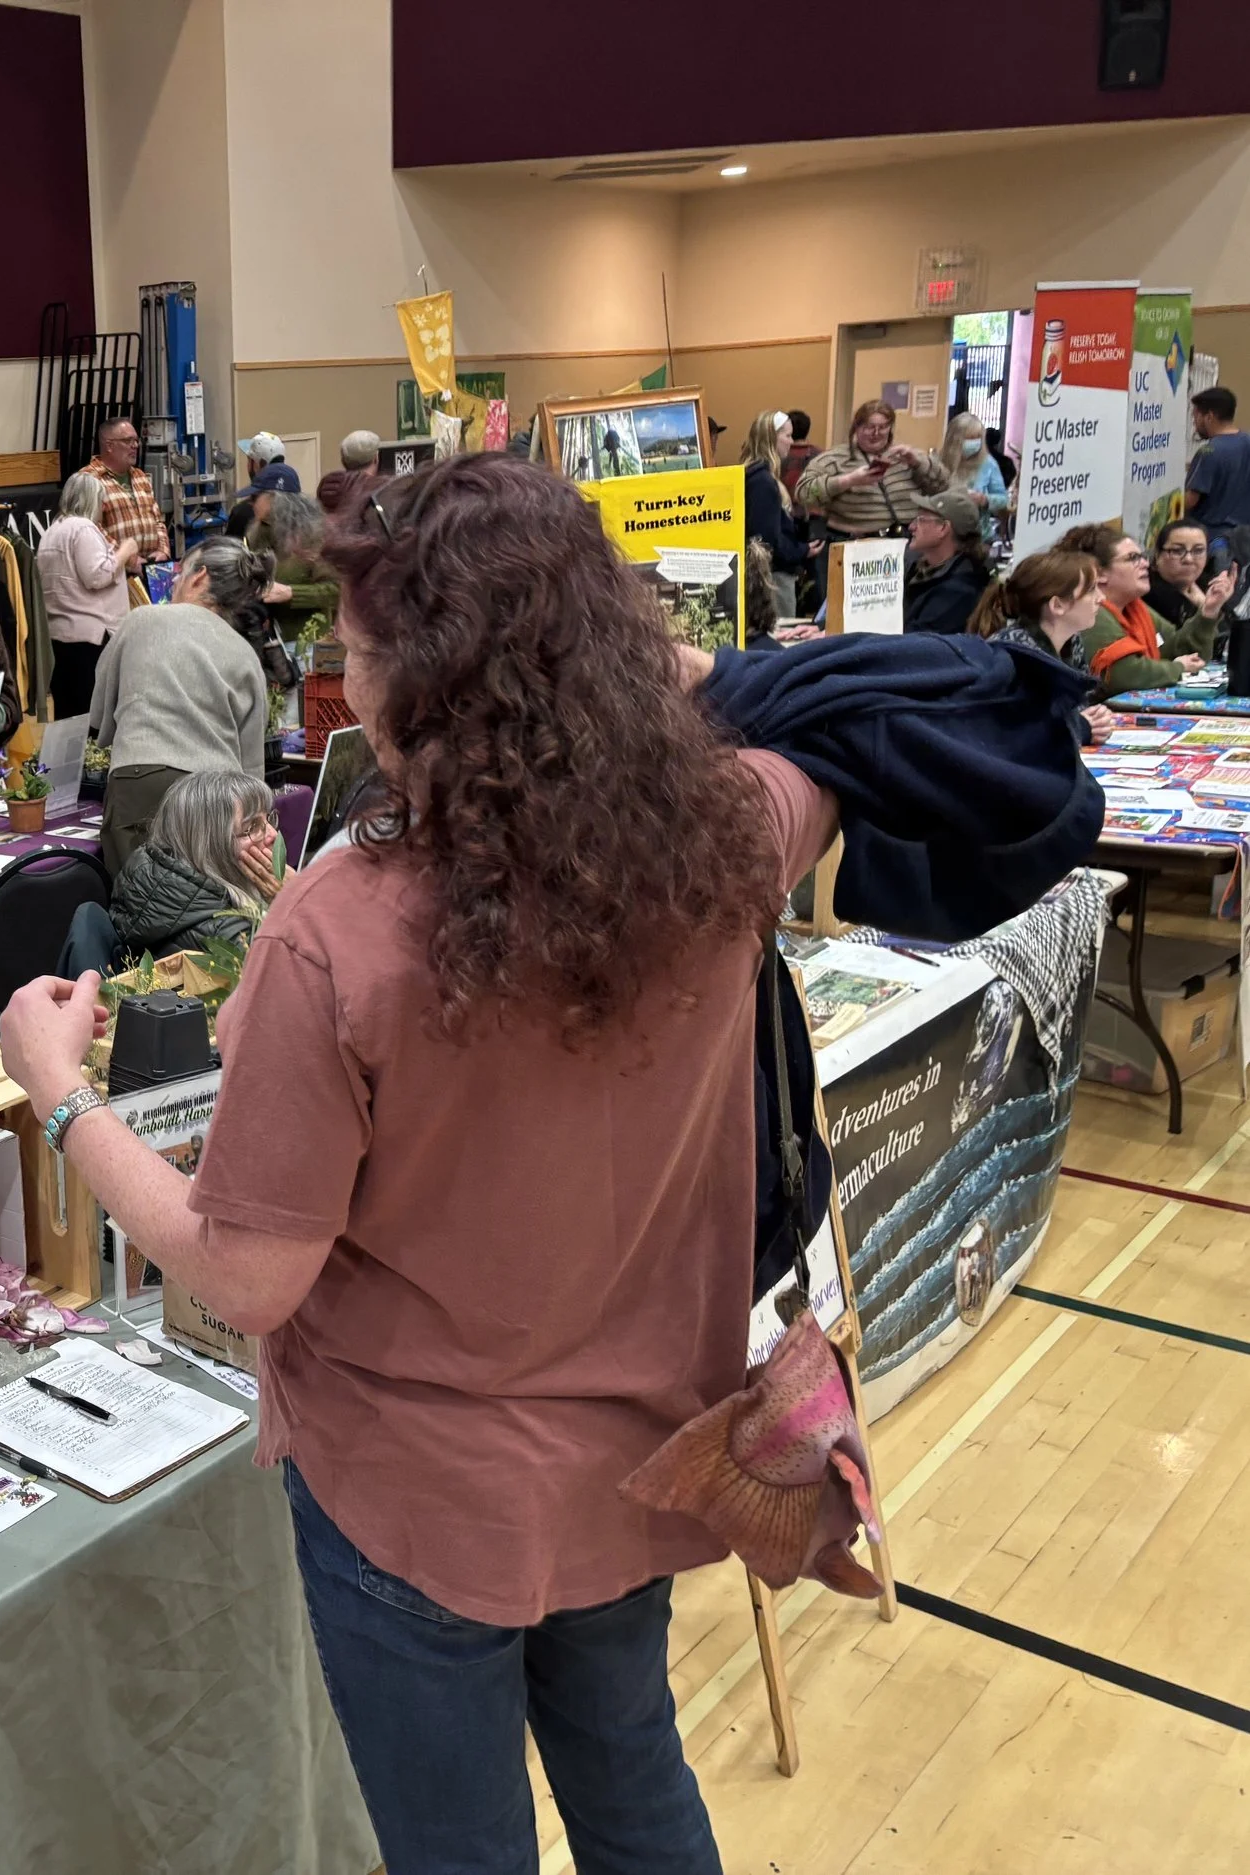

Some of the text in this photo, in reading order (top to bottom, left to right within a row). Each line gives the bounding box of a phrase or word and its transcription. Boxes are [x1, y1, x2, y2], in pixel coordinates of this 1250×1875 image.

[1070, 334, 1095, 348] PRESERVE
[1069, 350, 1087, 364] RELISH
[1135, 371, 1150, 392] UC
[1133, 402, 1163, 423] Master
[1035, 417, 1098, 443] UC Master
[1132, 430, 1171, 453] Gardener
[1032, 444, 1065, 471] Food
[1029, 471, 1090, 497] Preserver
[1131, 460, 1167, 485] Program
[634, 493, 706, 513] Turn-key
[1027, 498, 1083, 526] Program
[624, 508, 732, 533] Homesteading
[850, 580, 899, 599] MCKINLEYVILLE
[828, 1056, 943, 1149] dventures in
[837, 1118, 925, 1214] ermaculture
